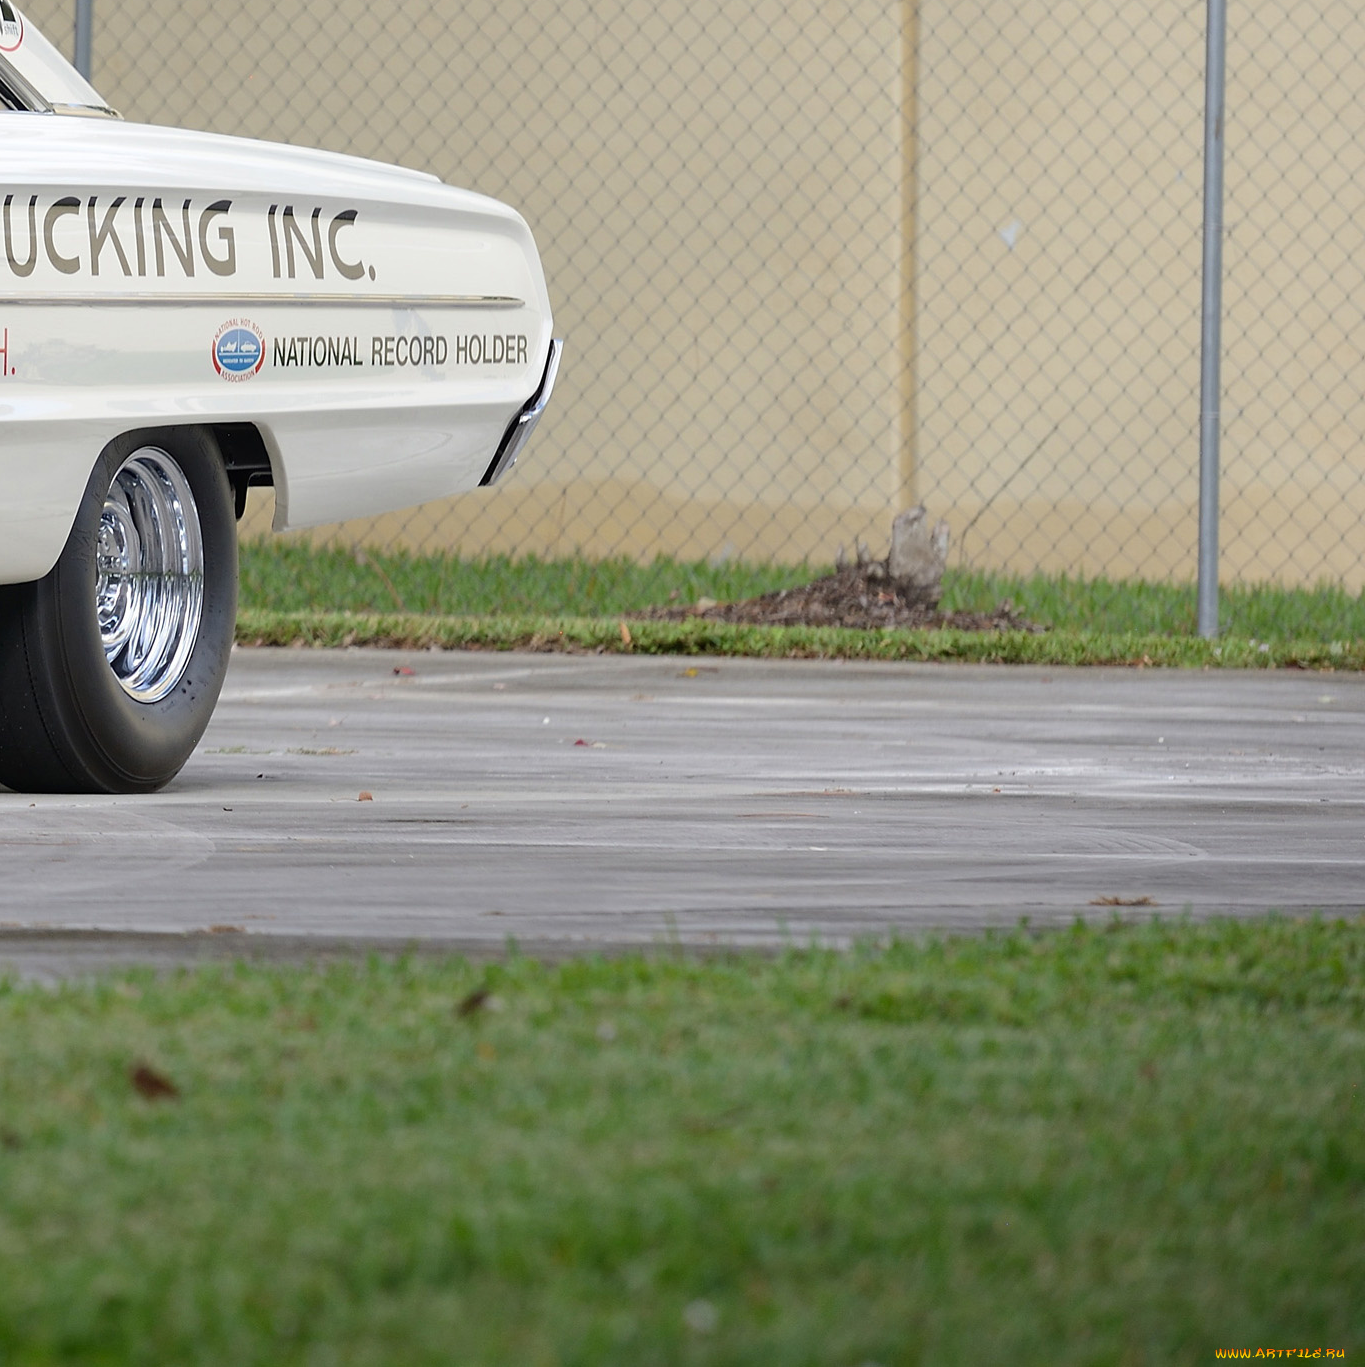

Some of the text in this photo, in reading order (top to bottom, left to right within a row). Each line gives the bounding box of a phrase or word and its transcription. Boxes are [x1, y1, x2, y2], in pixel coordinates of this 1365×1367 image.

[267, 204, 376, 282] INC.
[214, 318, 239, 341] NATIONAL
[240, 317, 251, 327] HOT
[273, 334, 529, 367] NATIONAL RECORD HOLDER
[220, 369, 256, 384] ASSOCIATION
